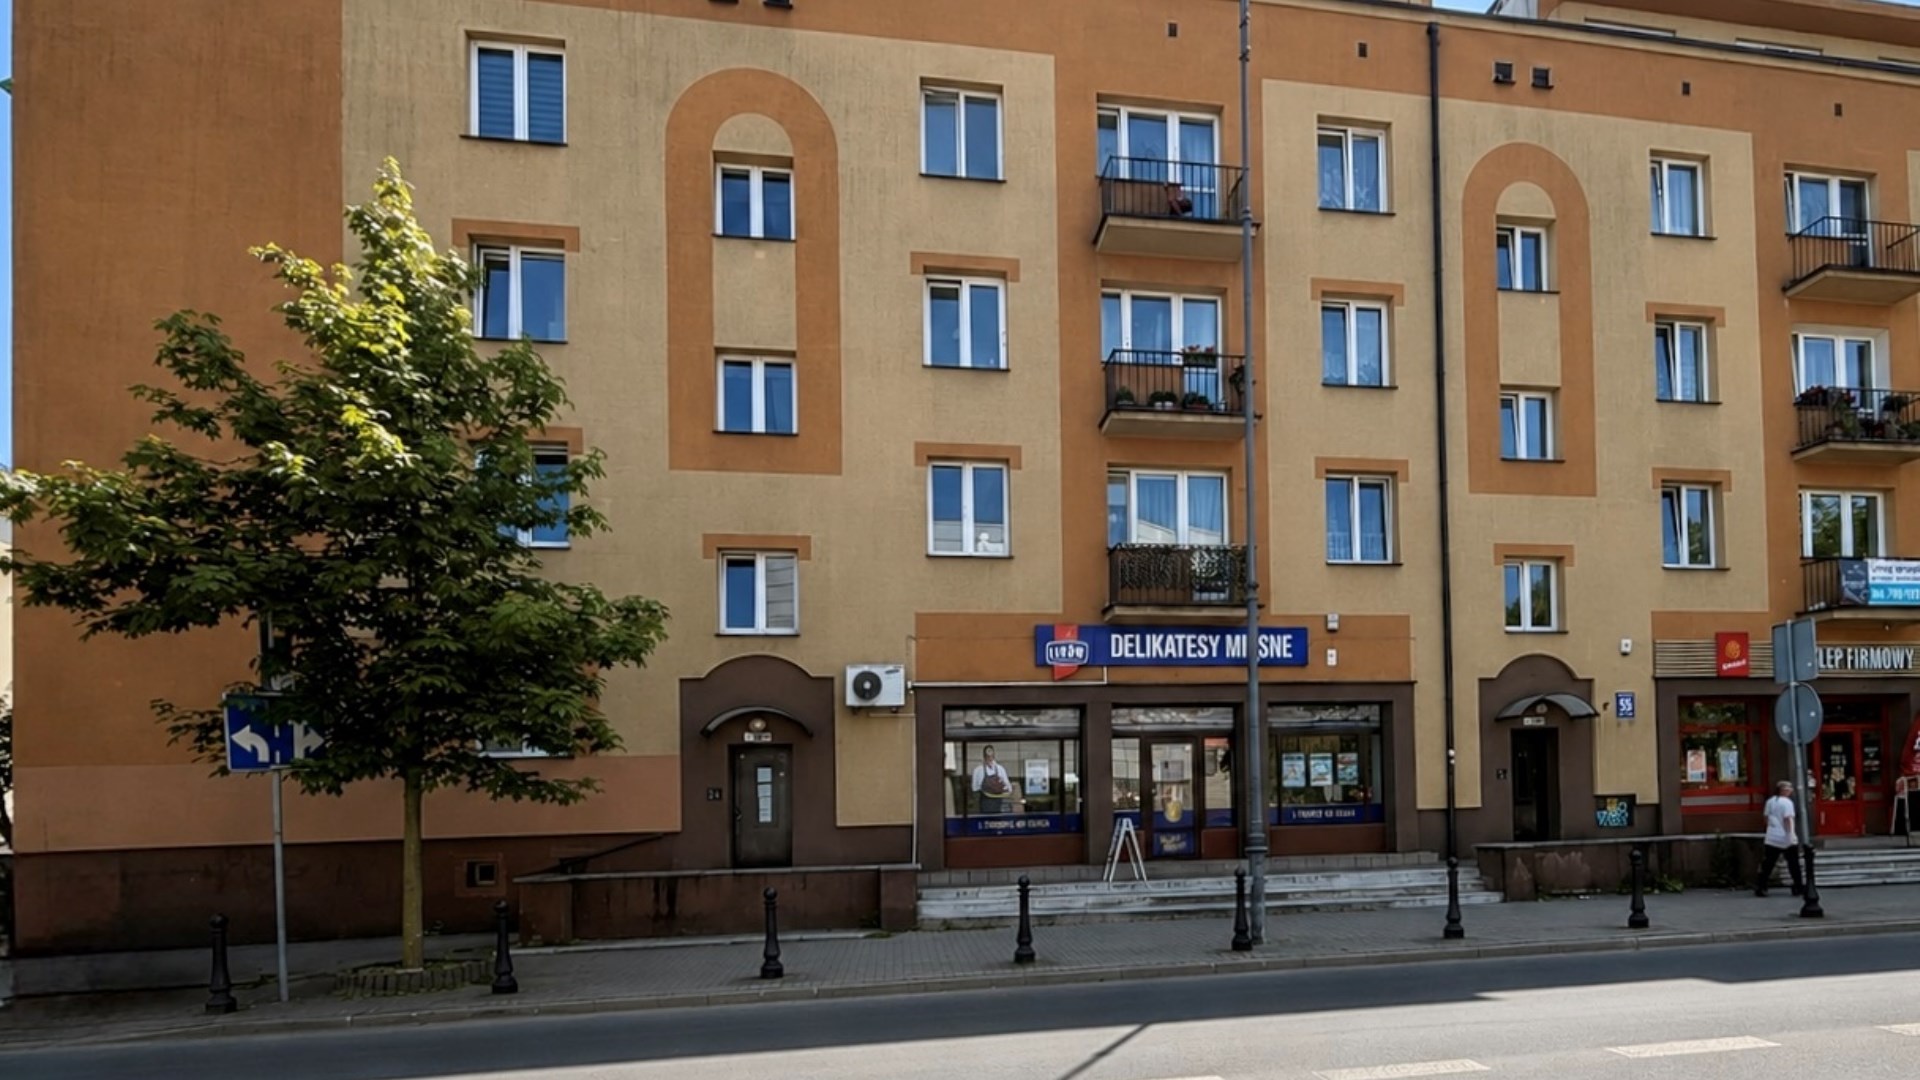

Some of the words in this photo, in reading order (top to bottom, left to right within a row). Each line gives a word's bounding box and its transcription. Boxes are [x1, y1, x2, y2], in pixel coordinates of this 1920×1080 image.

[1110, 633, 1221, 658] DELIKATESY
[1226, 634, 1293, 660] MISNE
[1816, 647, 1844, 669] LEP
[1847, 647, 1914, 669] FIRMOWY
